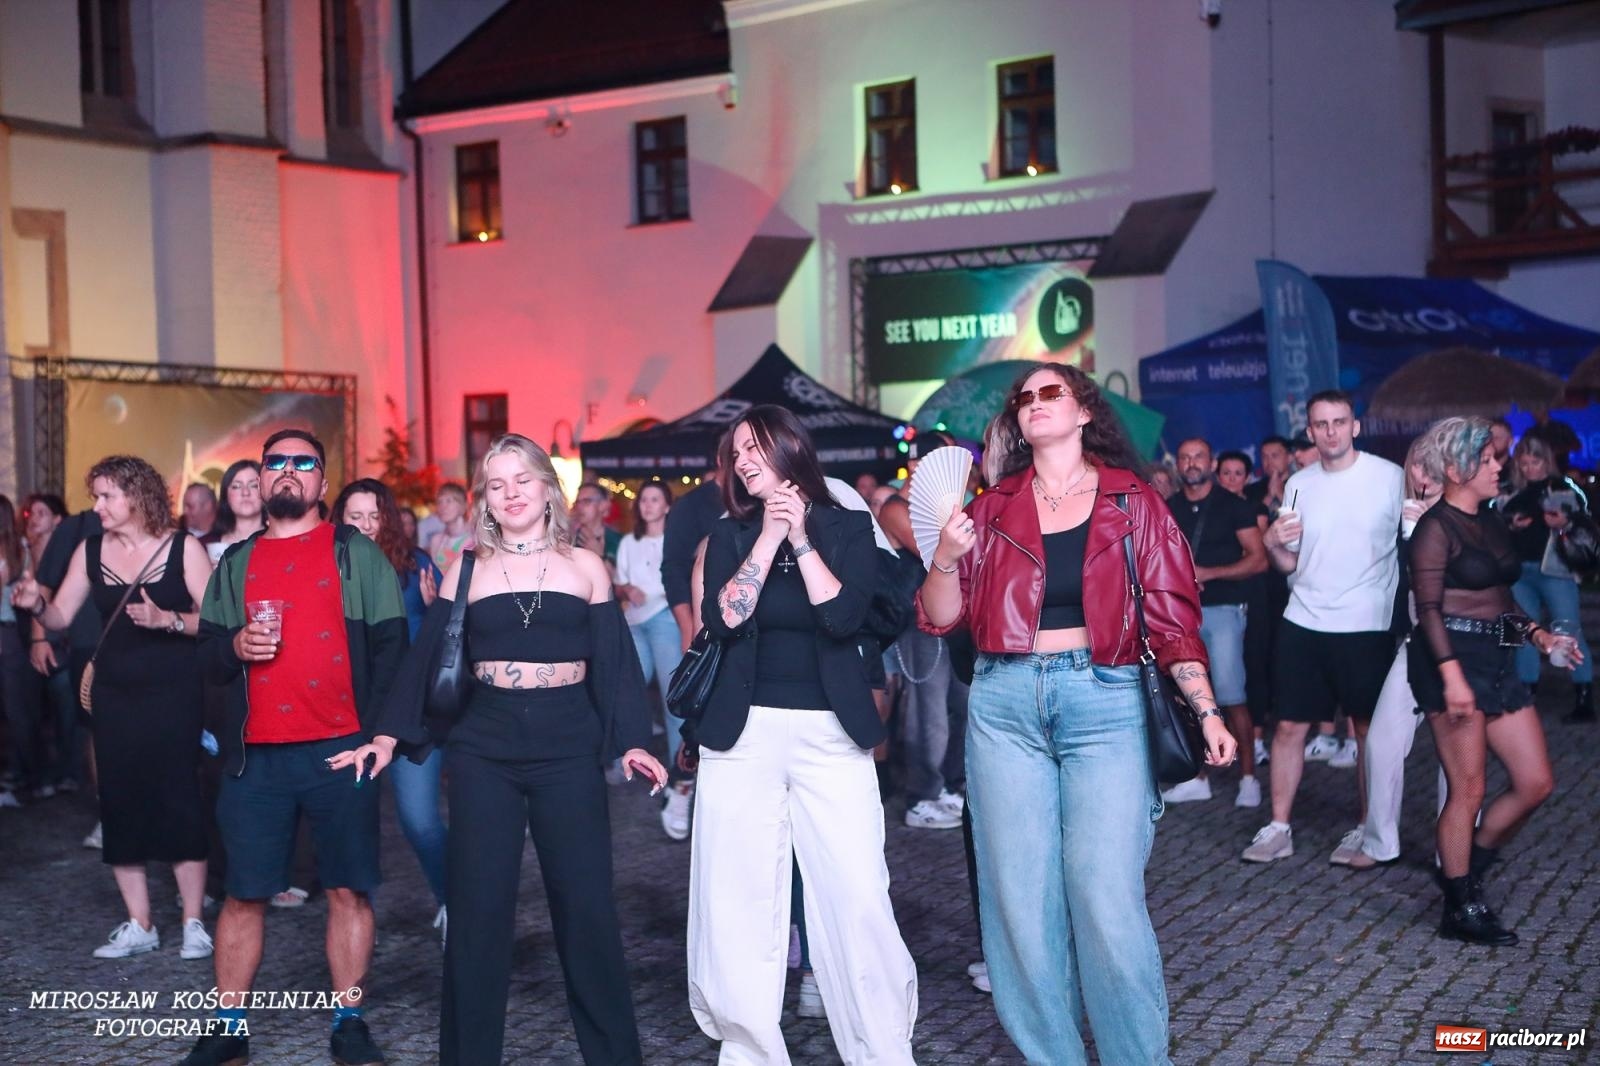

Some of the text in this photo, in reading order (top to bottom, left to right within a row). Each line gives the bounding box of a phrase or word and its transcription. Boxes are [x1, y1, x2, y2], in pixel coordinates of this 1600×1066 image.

[885, 313, 1017, 343] SEE YOU NEXT YEAR
[1149, 365, 1198, 382] internet
